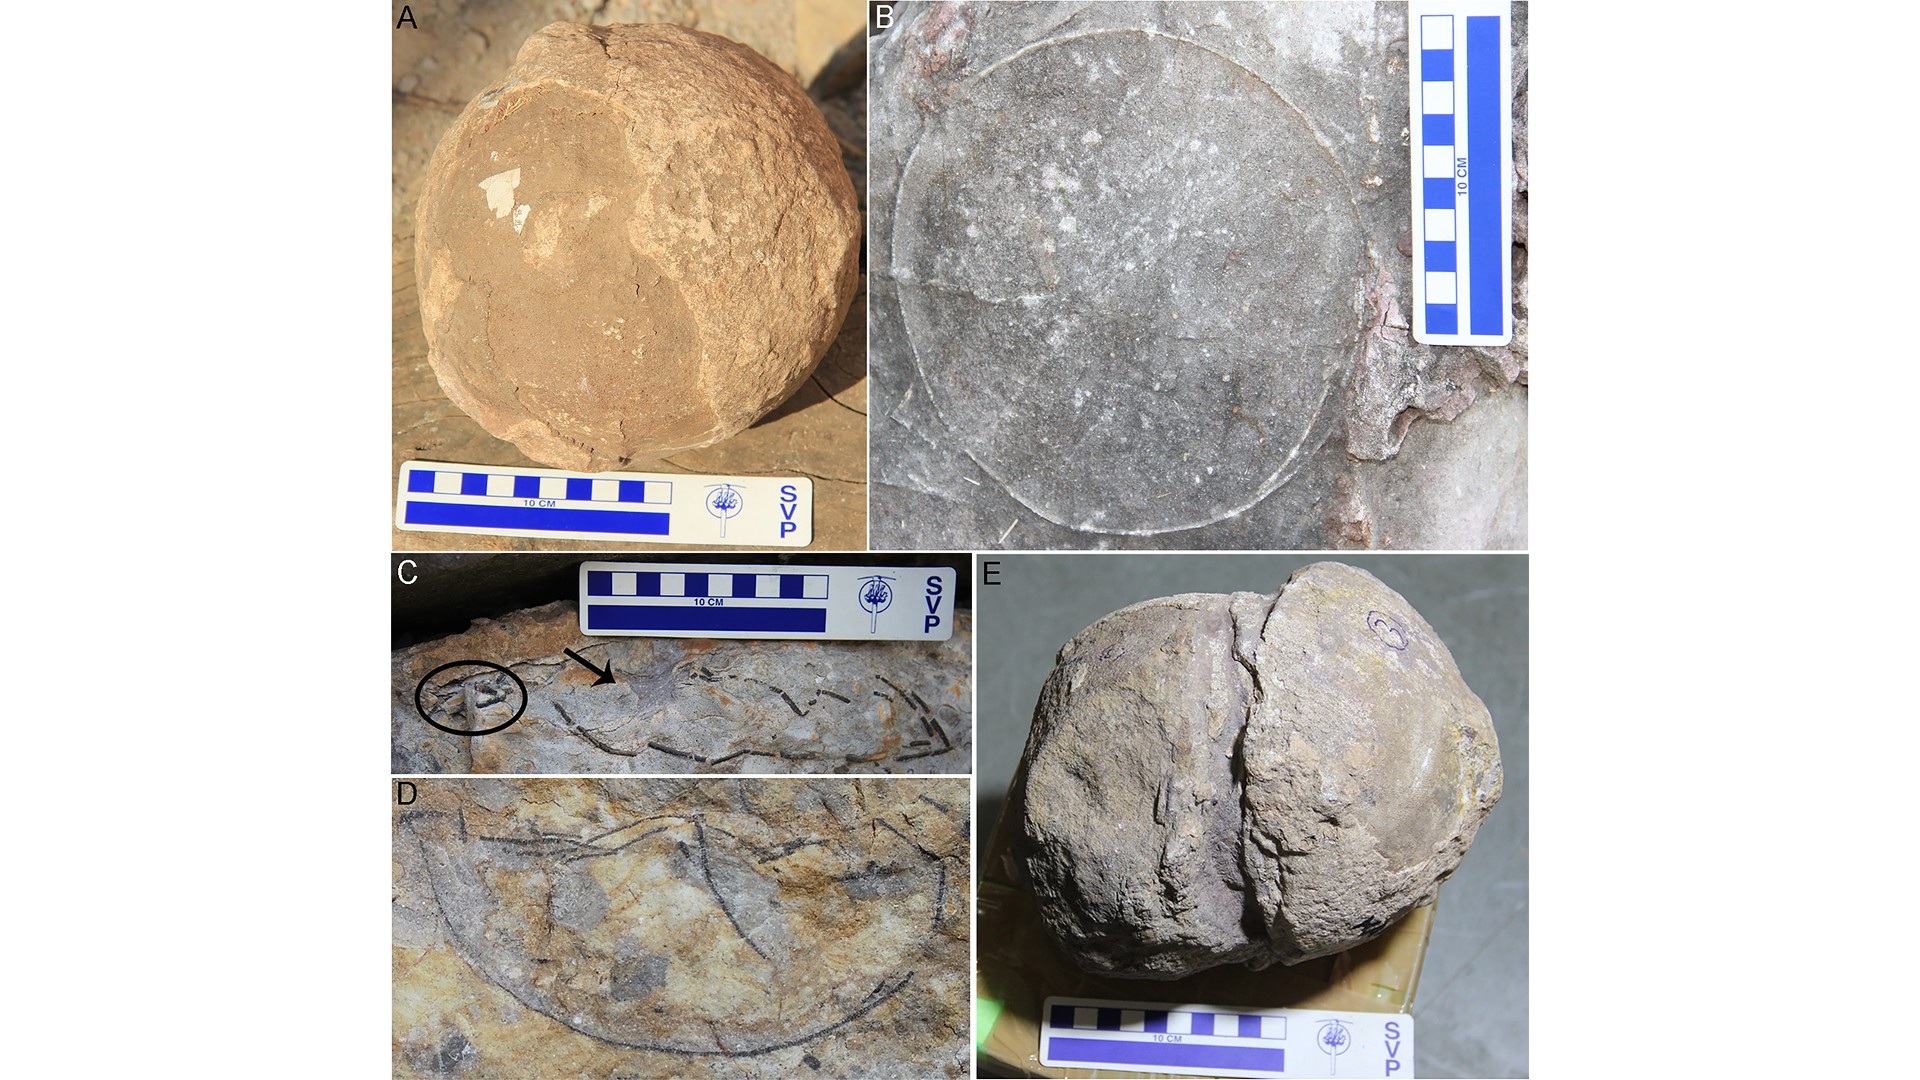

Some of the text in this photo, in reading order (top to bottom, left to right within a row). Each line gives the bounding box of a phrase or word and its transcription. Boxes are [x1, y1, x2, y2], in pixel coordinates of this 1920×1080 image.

[1456, 157, 1467, 197] 10 CM
[523, 499, 556, 508] 10 CM
[780, 484, 797, 539] SVP
[694, 598, 724, 606] 10 CM
[924, 575, 943, 634] SVP
[1153, 1034, 1182, 1043] 10 CM
[1384, 1021, 1401, 1077] SVP
